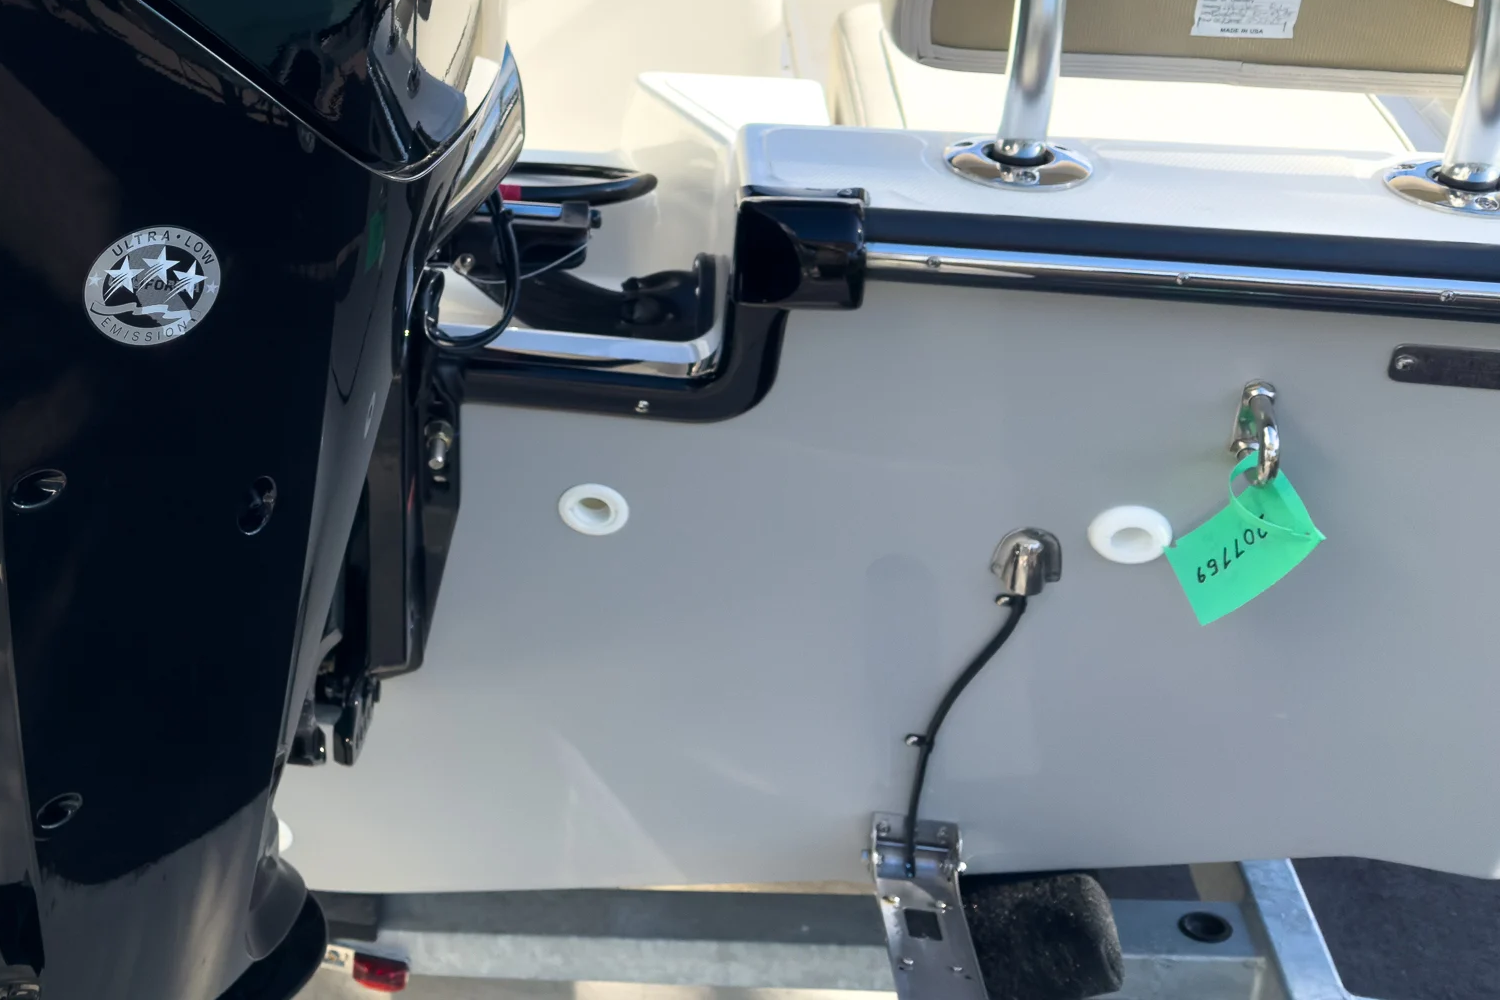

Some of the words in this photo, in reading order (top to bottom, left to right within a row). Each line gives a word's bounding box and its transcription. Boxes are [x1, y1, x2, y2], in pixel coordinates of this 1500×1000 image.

[111, 230, 171, 257] ULTRA
[184, 235, 215, 265] LOW
[100, 316, 193, 343] EMISSION
